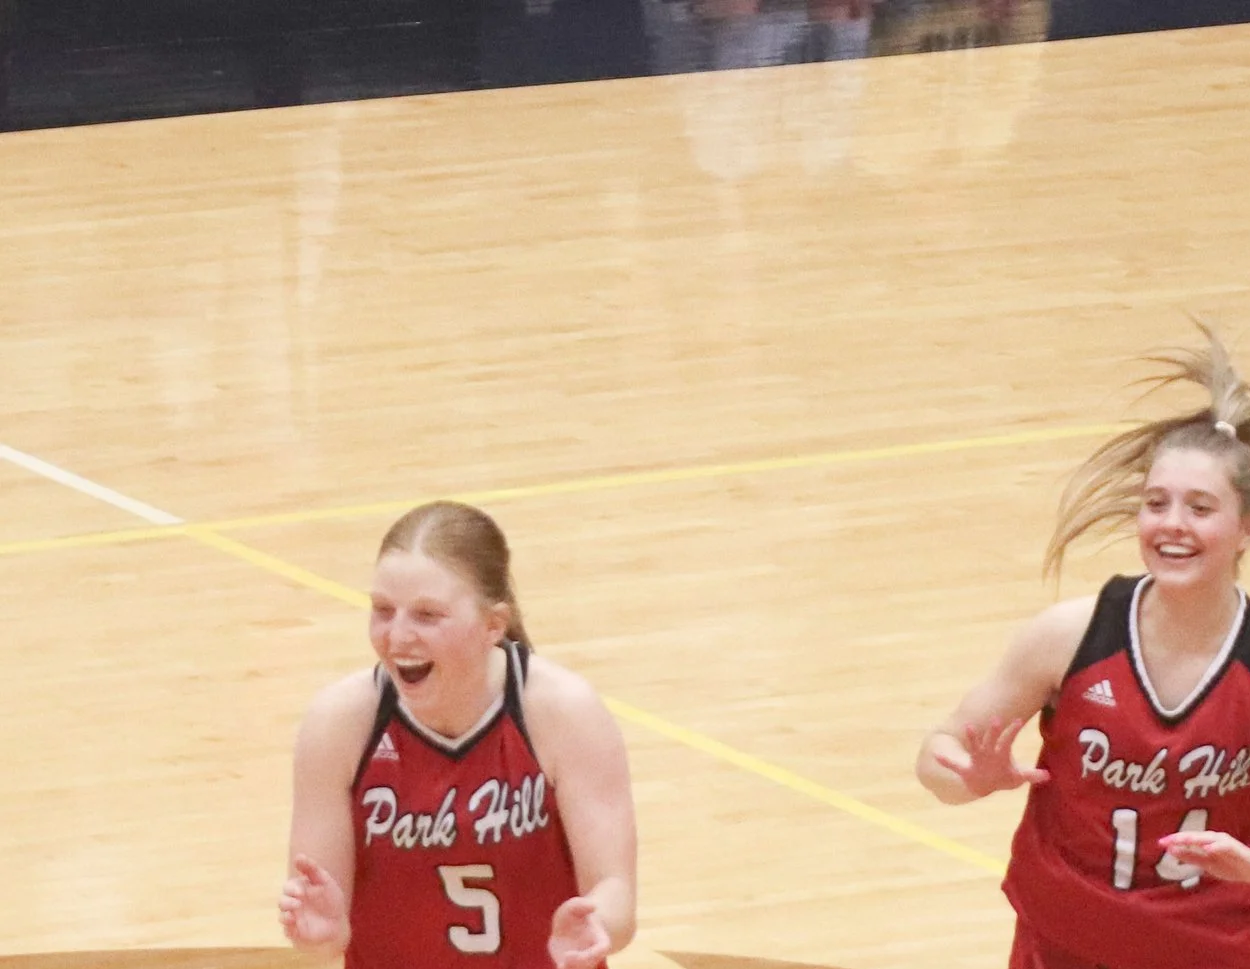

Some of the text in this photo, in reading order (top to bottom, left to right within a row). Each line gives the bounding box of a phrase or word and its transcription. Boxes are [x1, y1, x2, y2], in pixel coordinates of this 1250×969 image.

[1078, 727, 1168, 795] Park
[361, 771, 550, 848] Park Hill
[1111, 807, 1210, 890] 14
[436, 862, 502, 954] 5
